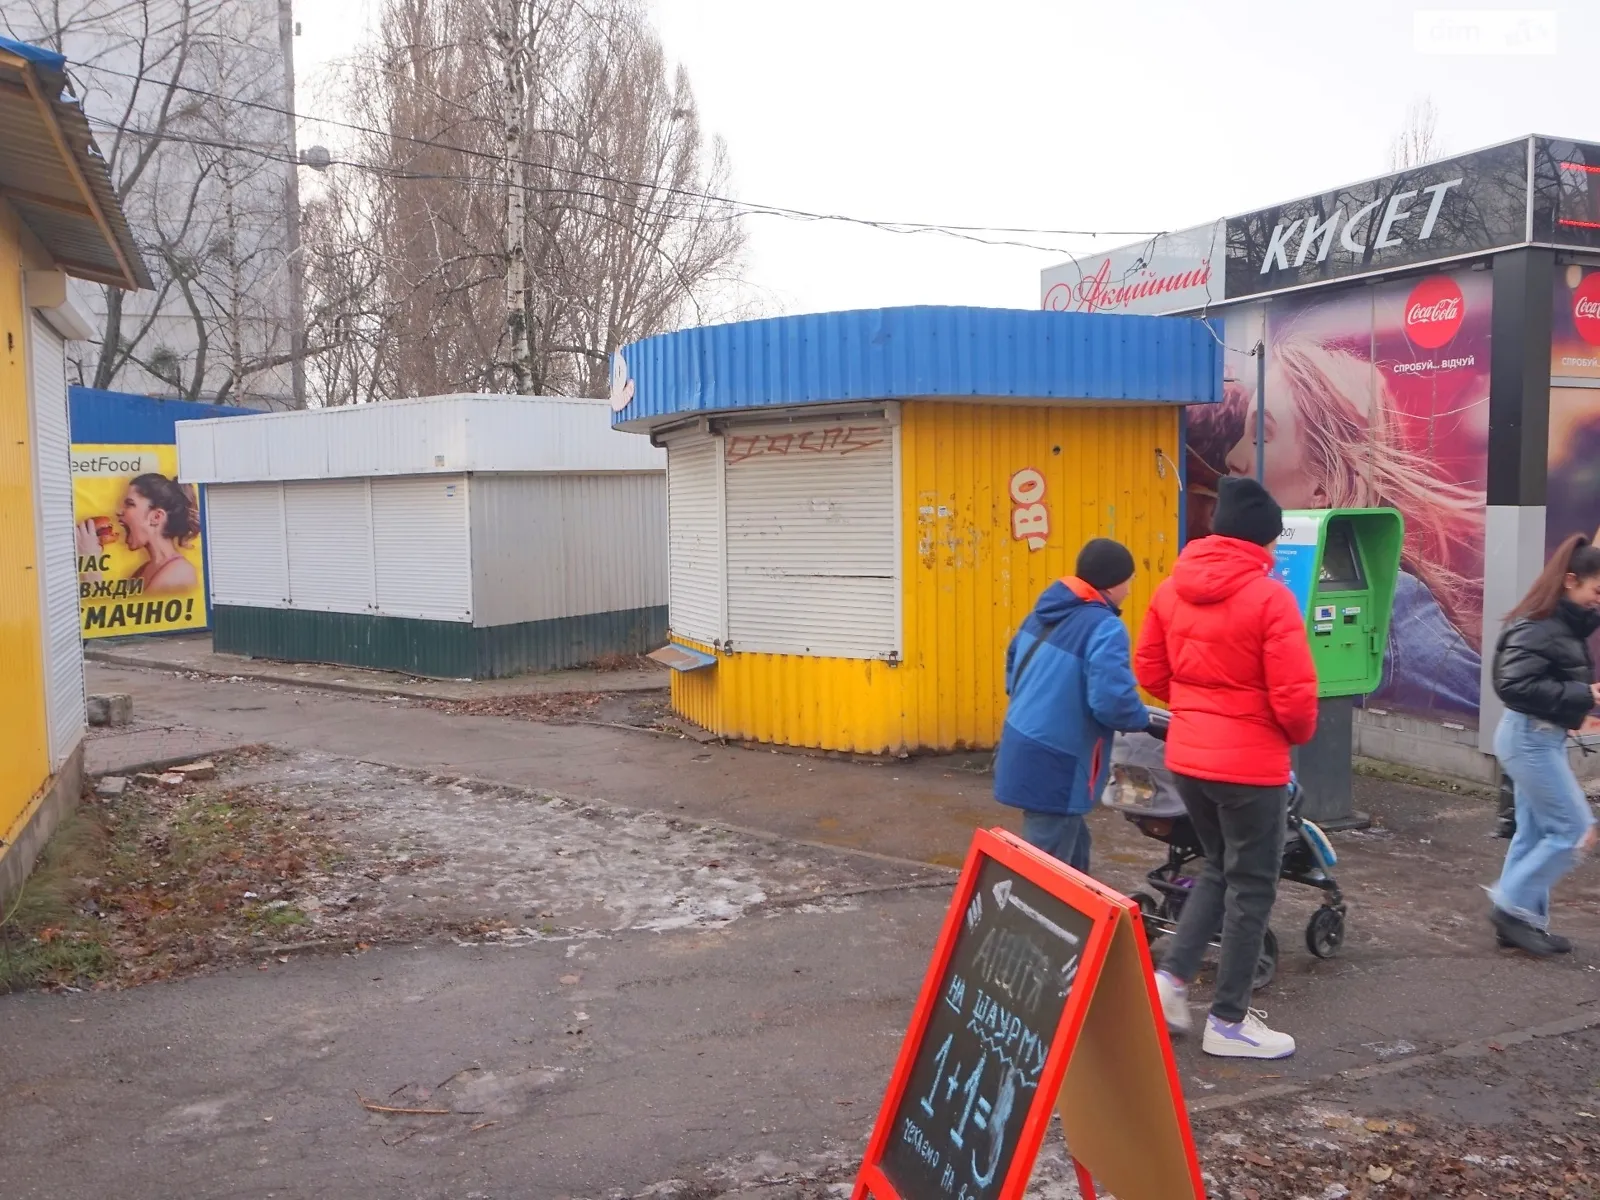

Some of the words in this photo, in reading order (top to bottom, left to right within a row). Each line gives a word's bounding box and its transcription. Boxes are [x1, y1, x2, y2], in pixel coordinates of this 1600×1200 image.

[1259, 177, 1463, 275] КИСЕТ
[1043, 257, 1213, 313] Акційний
[1441, 354, 1475, 369] ВІДЧУЙ
[80, 598, 194, 630] МАЧНО!
[972, 988, 1049, 1075] ШАУРМУ
